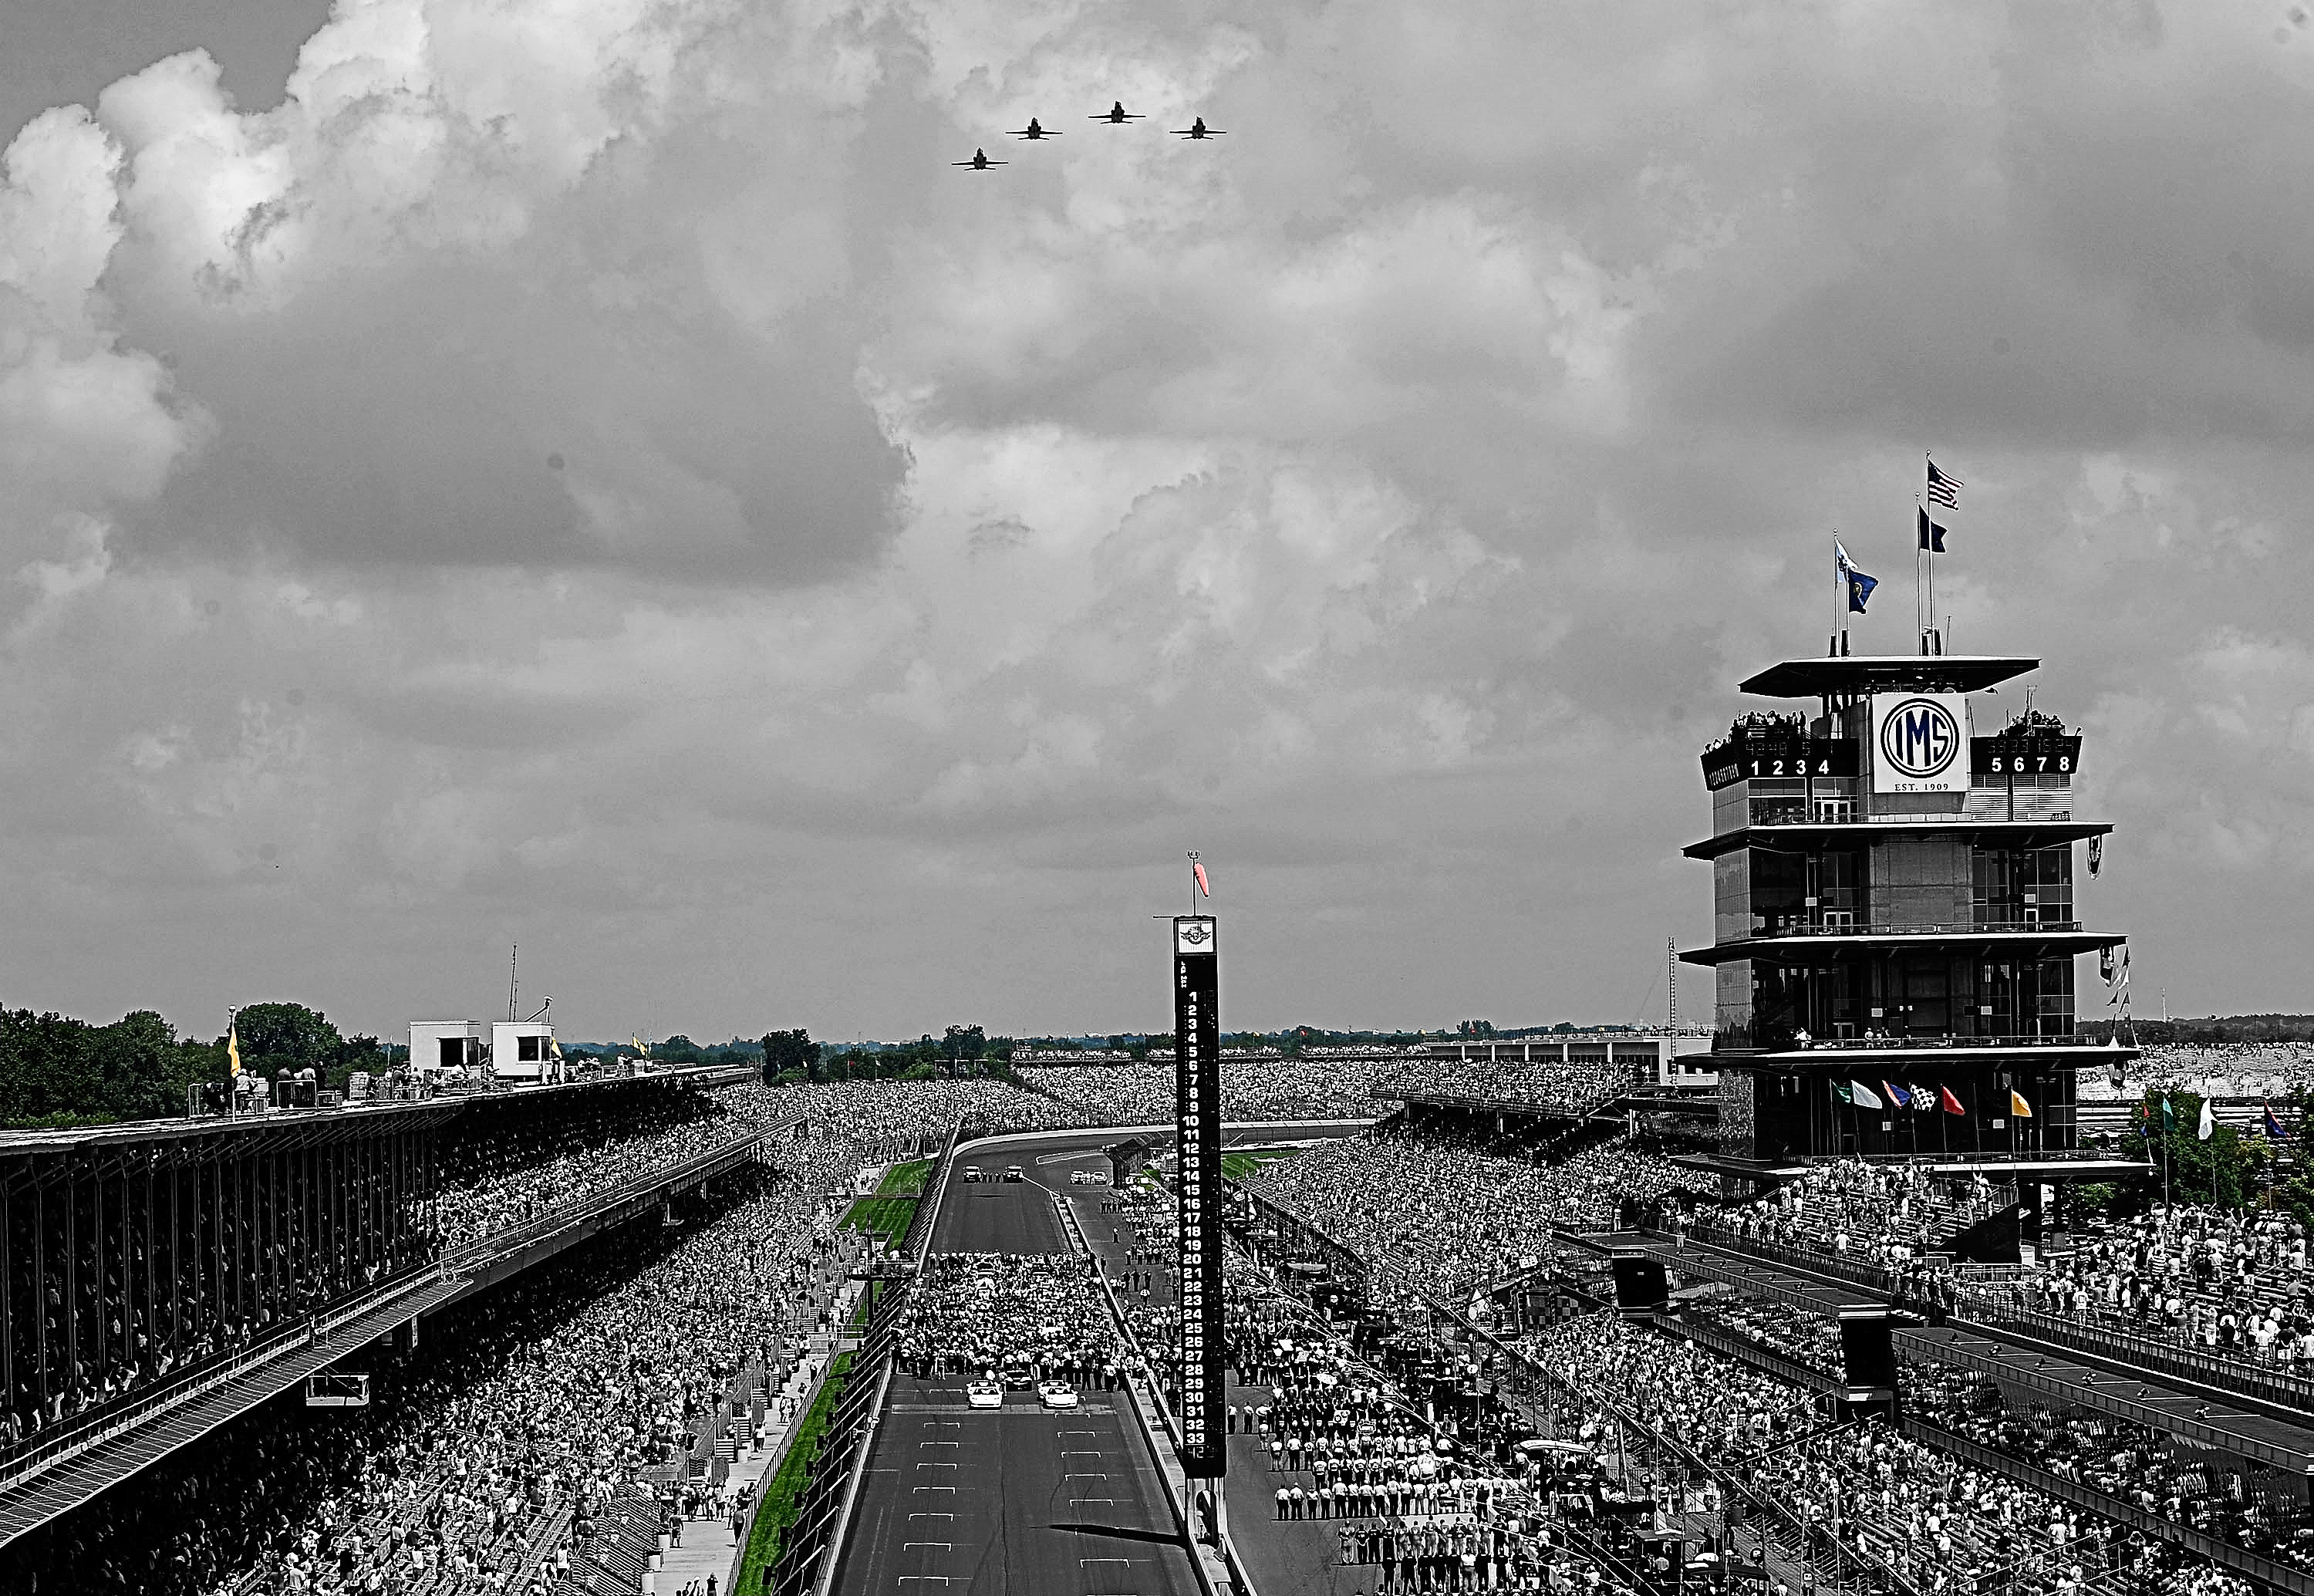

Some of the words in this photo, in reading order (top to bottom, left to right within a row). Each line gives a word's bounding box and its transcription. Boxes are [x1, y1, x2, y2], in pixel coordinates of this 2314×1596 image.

[1895, 709, 1949, 768] IMS
[1751, 760, 1759, 776] 1
[1773, 760, 1783, 775] 2
[1796, 759, 1806, 775] 3
[1818, 759, 1830, 774] 4
[1992, 757, 2002, 772] 5
[2013, 756, 2025, 772] 6
[2036, 756, 2048, 772] 7
[2059, 756, 2069, 771] 8
[1894, 783, 1918, 791] EST.
[1189, 991, 1197, 1002] 1
[1188, 1004, 1197, 1016] 2
[1188, 1017, 1198, 1030] 3
[1187, 1032, 1198, 1044] 4
[1189, 1046, 1198, 1058] 5
[1189, 1060, 1198, 1071] 6
[1189, 1074, 1199, 1085] 7
[1189, 1087, 1199, 1099] 8
[1189, 1101, 1199, 1112] 9
[1182, 1115, 1199, 1127] 10
[1183, 1129, 1199, 1140] 11
[1182, 1142, 1199, 1154] 12
[1182, 1156, 1200, 1169] 13
[1182, 1170, 1200, 1182] 14
[1182, 1184, 1200, 1196] 15
[1183, 1198, 1201, 1210] 16
[1183, 1212, 1201, 1223] 17
[1183, 1226, 1202, 1237] 18
[1184, 1240, 1202, 1251] 19
[1182, 1253, 1202, 1265] 20
[1183, 1267, 1203, 1279] 21
[1183, 1281, 1203, 1293] 22
[1183, 1294, 1203, 1306] 23
[1183, 1308, 1203, 1320] 24
[1184, 1322, 1203, 1334] 25
[1185, 1336, 1203, 1348] 26
[1185, 1350, 1203, 1361] 27
[1185, 1364, 1204, 1376] 28
[1185, 1378, 1204, 1389] 29
[1185, 1392, 1204, 1403] 30
[1186, 1405, 1205, 1417] 31
[1186, 1419, 1205, 1430] 32
[1186, 1432, 1205, 1444] 33
